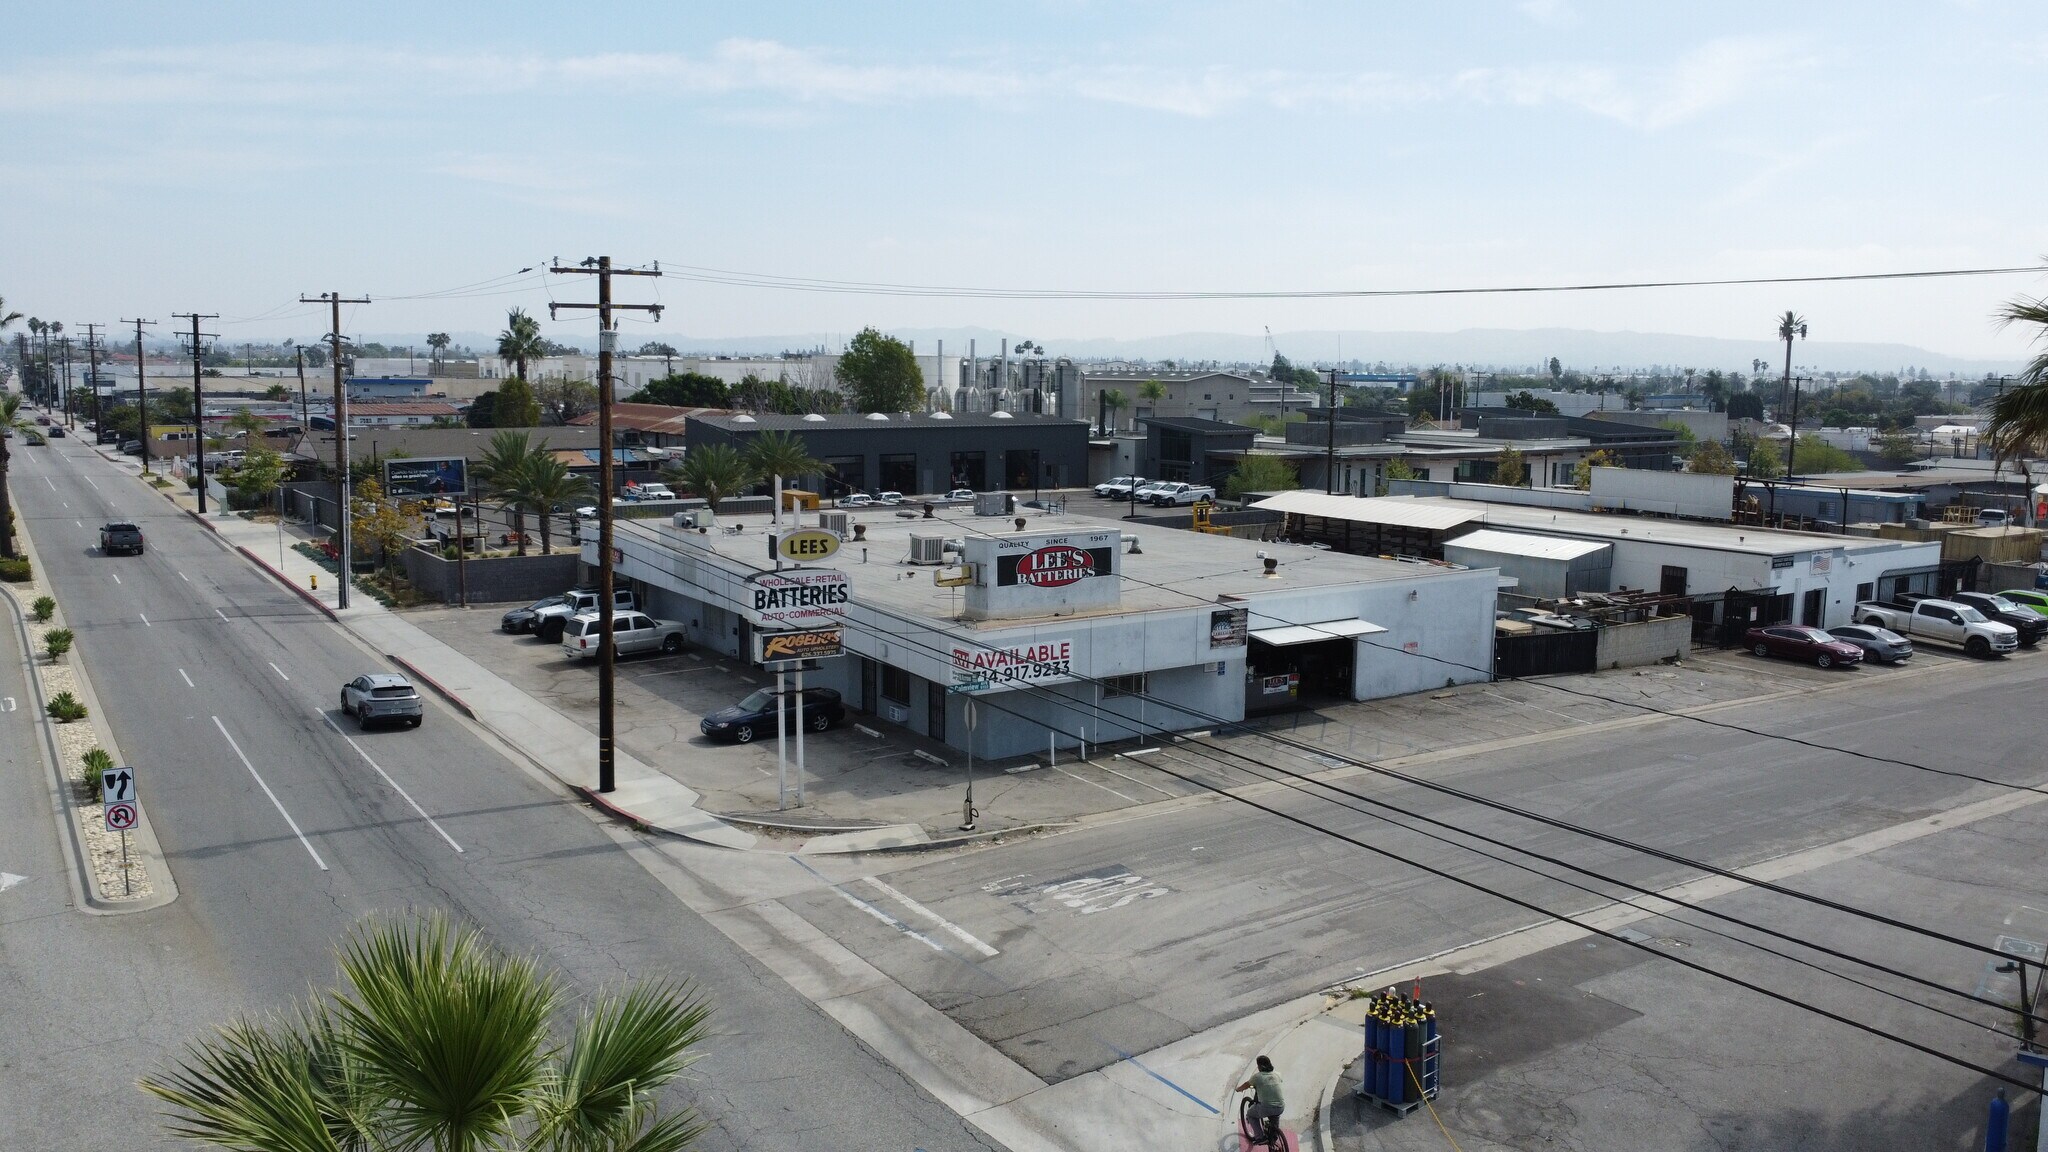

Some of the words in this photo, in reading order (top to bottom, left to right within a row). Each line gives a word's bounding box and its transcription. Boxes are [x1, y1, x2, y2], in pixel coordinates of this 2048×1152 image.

[790, 539, 828, 555] LEES
[999, 541, 1030, 549] QUALITY
[1031, 550, 1084, 570] LEE'S
[1017, 567, 1096, 584] BATTERIES
[755, 583, 848, 610] BATTERIES
[972, 643, 1070, 669] AVAILABLE
